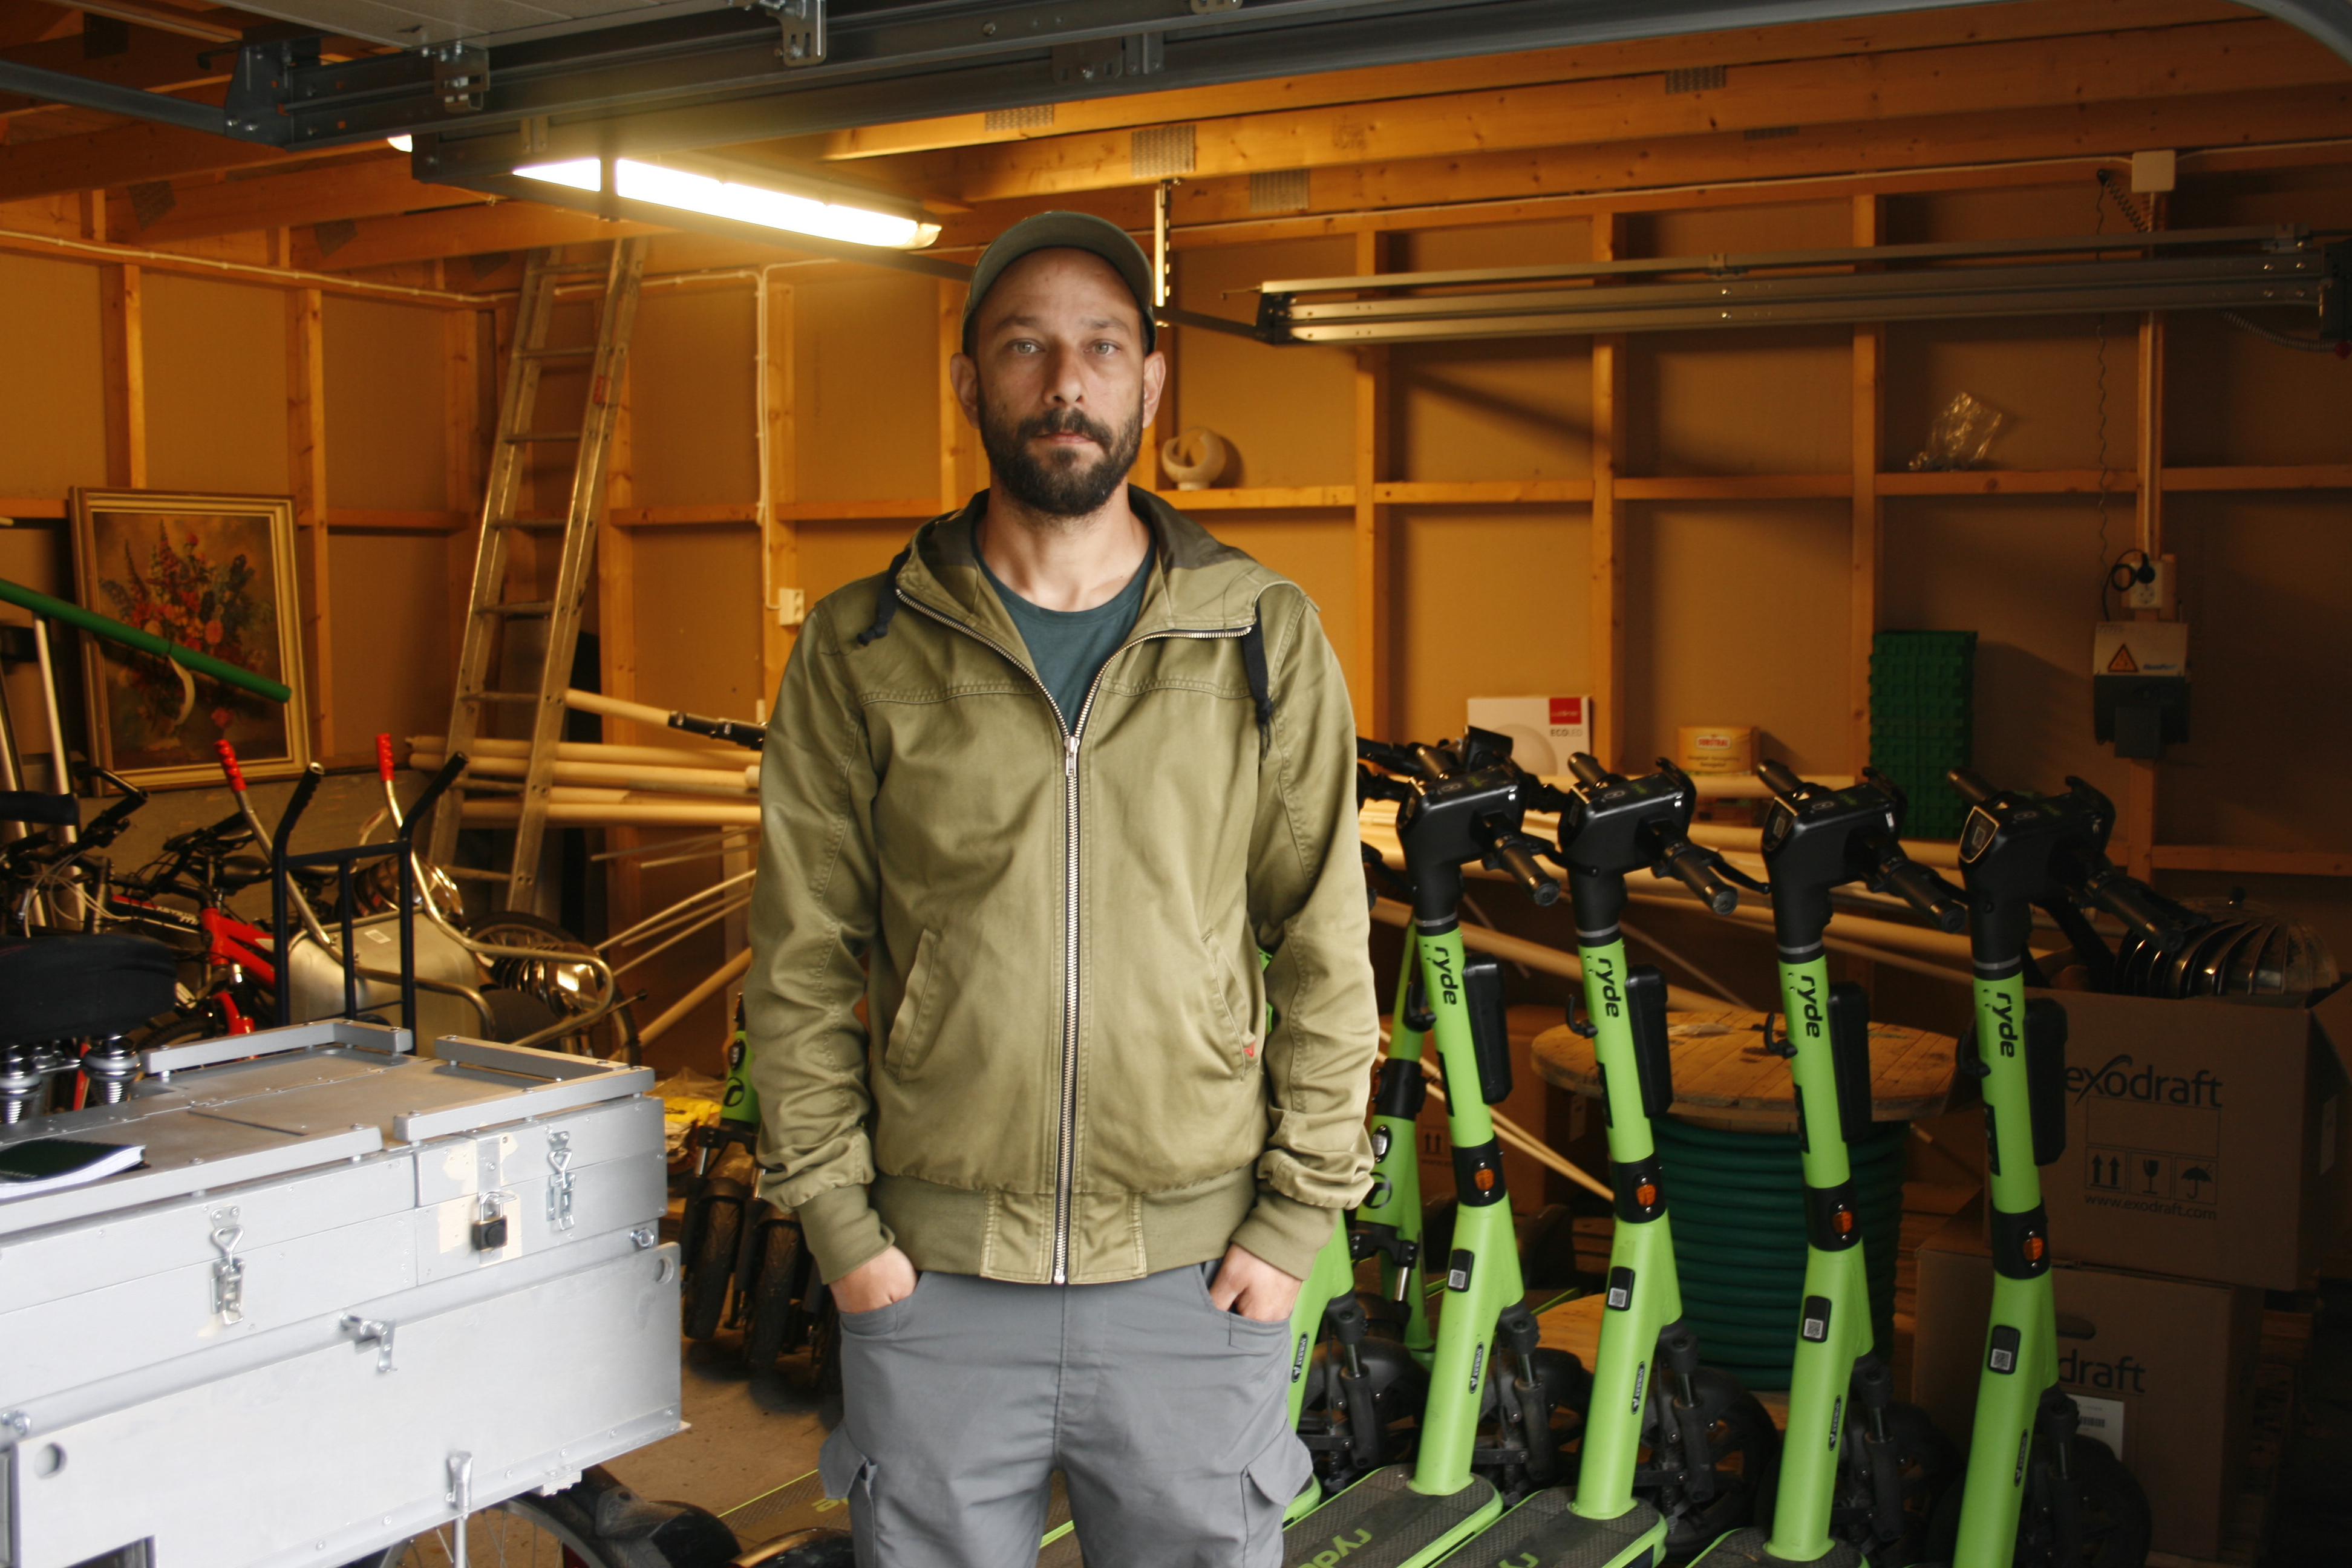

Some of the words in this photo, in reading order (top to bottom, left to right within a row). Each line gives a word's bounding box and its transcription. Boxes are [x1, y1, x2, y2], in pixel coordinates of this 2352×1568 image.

[1433, 947, 1459, 1005] ryde
[1596, 958, 1621, 1017] ryde
[1797, 975, 1823, 1037] ryde
[1992, 992, 2018, 1057] ryde
[2064, 1054, 2223, 1107] exodraft
[2085, 1194, 2217, 1221] www.exodraft.com
[2058, 1349, 2146, 1393] draft
[1296, 1528, 1373, 1568] ryd
